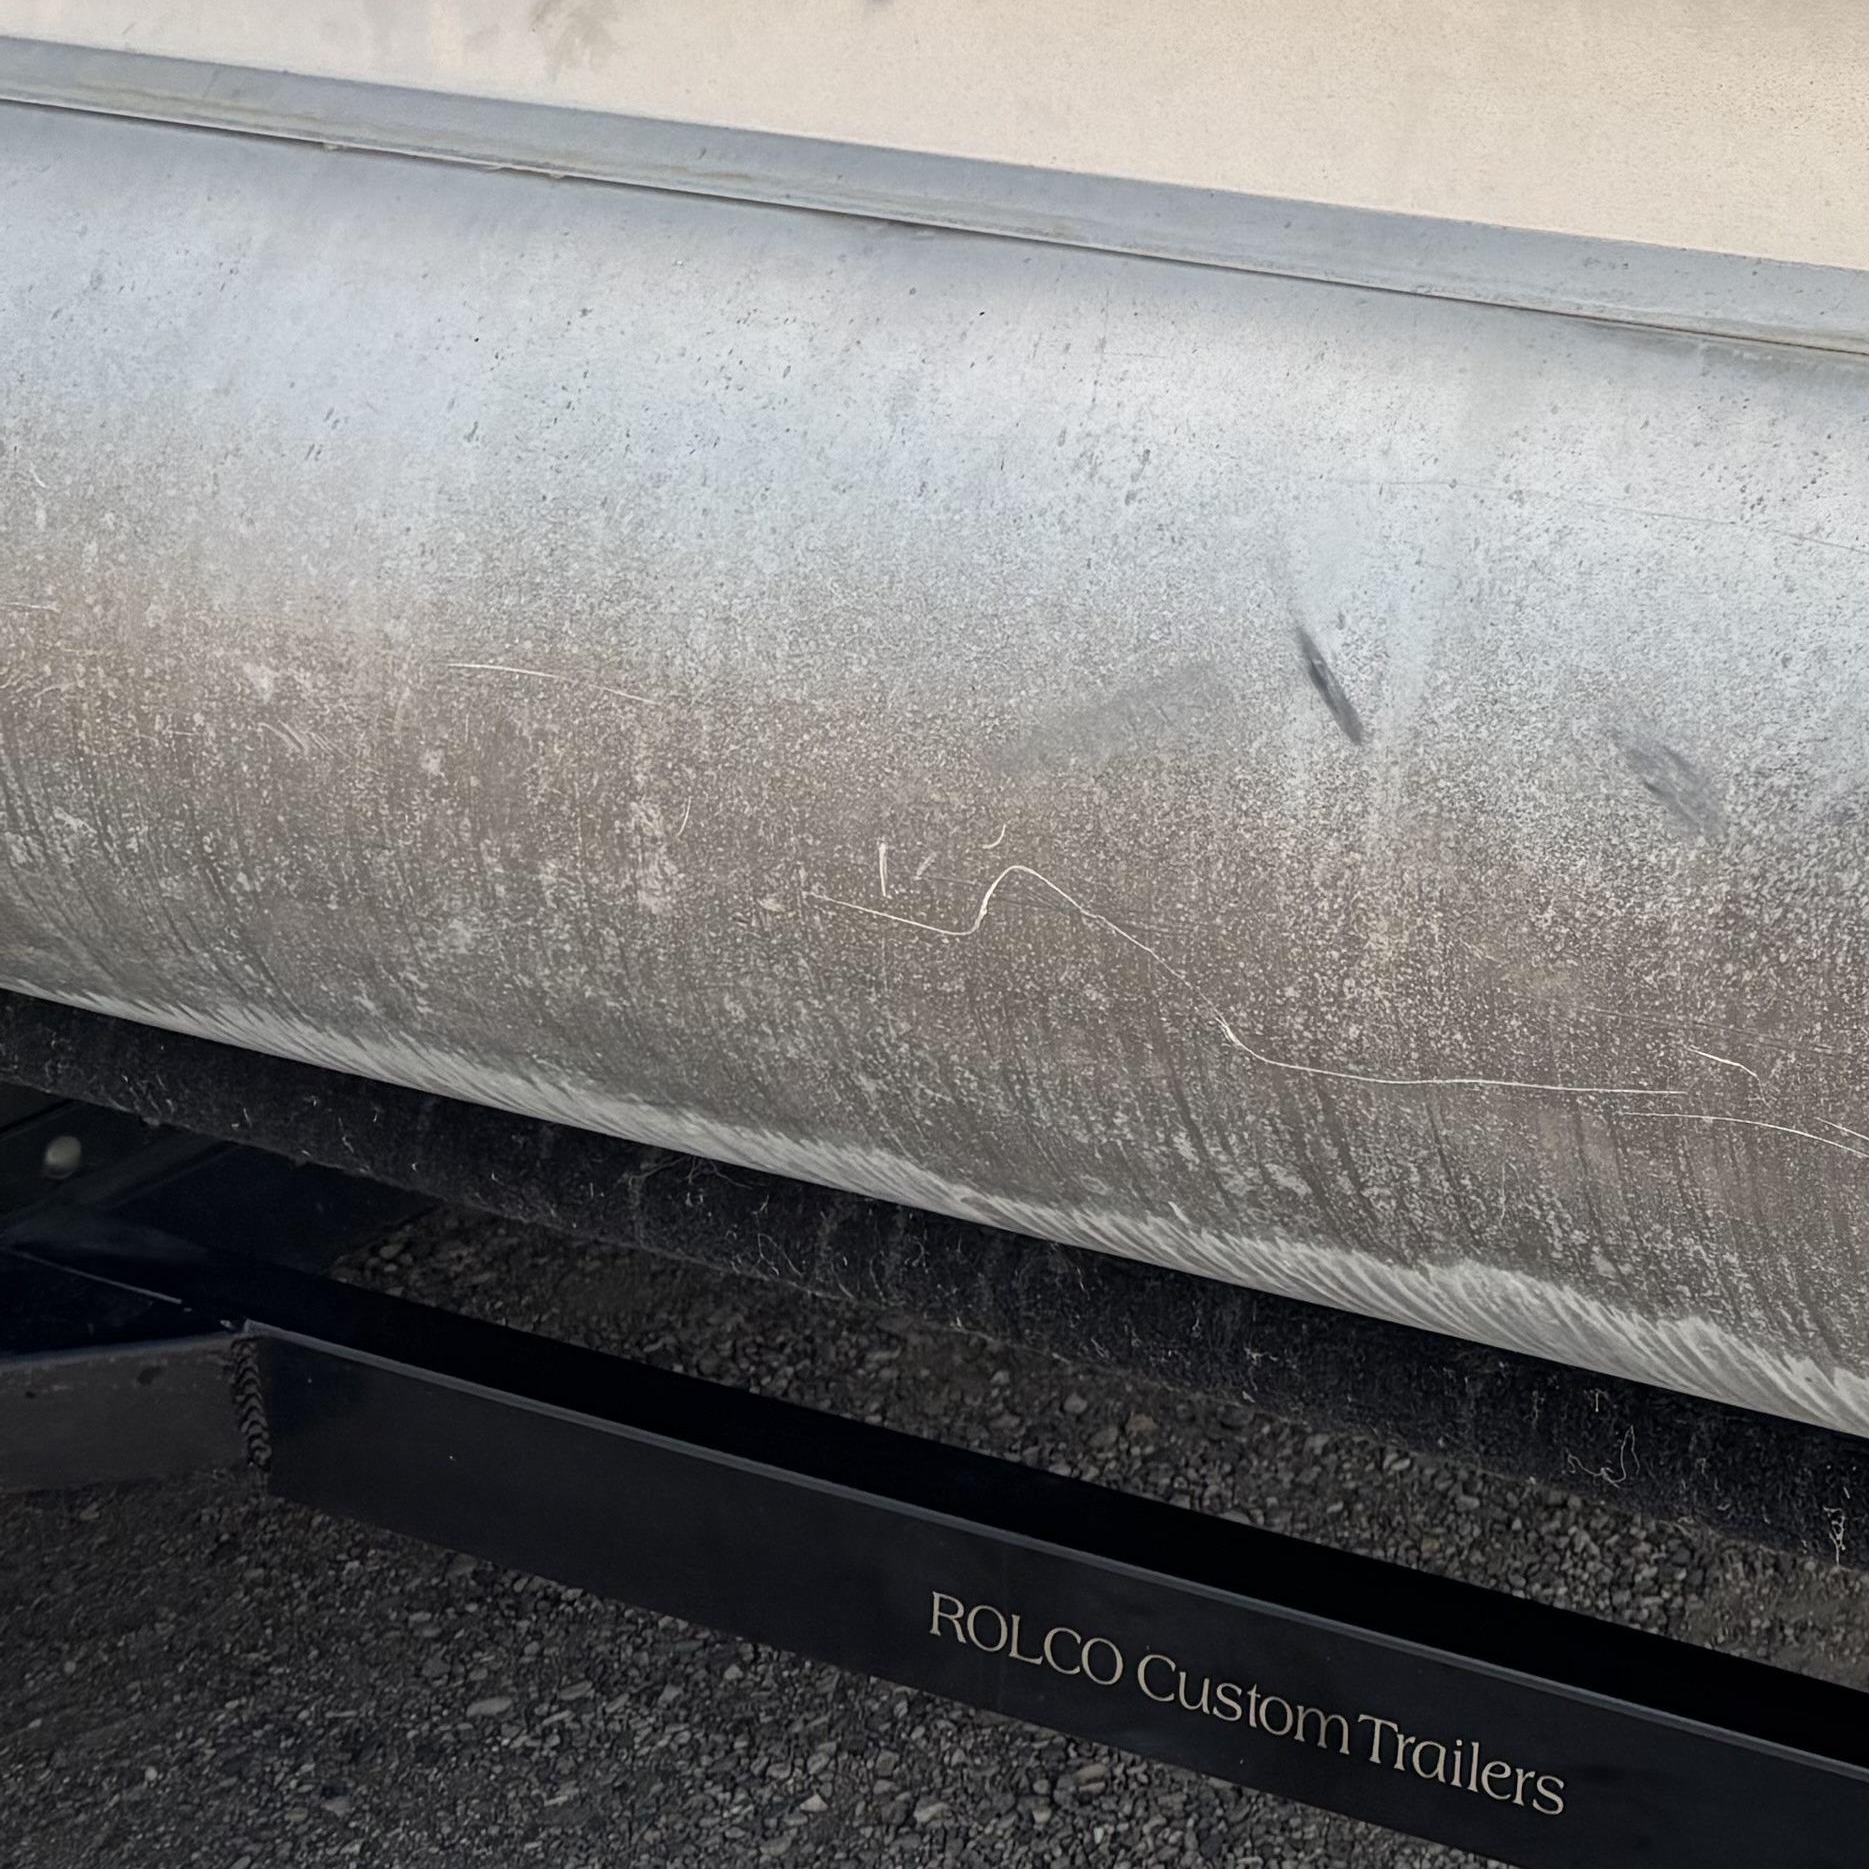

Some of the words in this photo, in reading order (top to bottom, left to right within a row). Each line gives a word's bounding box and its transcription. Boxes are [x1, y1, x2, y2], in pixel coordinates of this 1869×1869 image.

[928, 1590, 1124, 1686] ROLCO
[1136, 1653, 1351, 1756] Custom
[1357, 1713, 1567, 1817] Trailers
